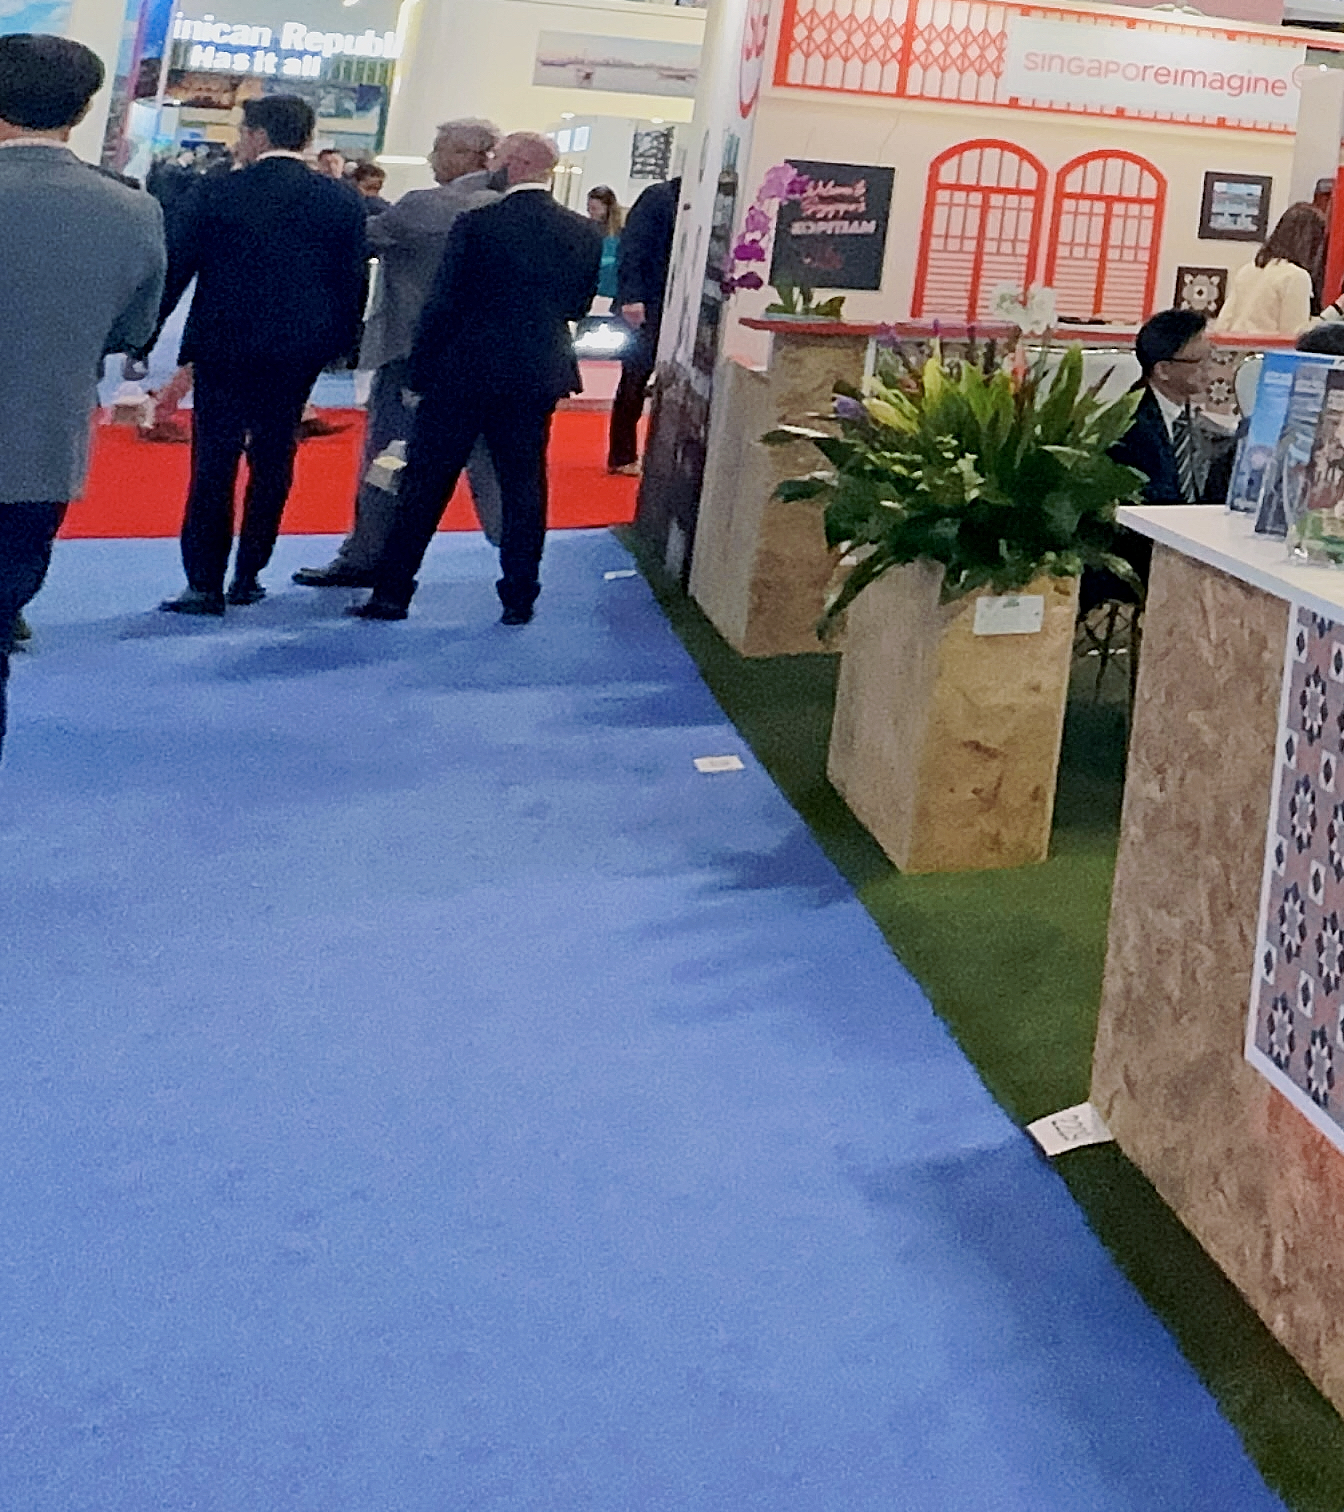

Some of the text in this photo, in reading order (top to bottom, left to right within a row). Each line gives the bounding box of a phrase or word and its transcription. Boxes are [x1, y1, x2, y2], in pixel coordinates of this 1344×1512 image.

[173, 11, 401, 59] inican Republ
[190, 45, 251, 72] Has
[282, 54, 322, 78] all
